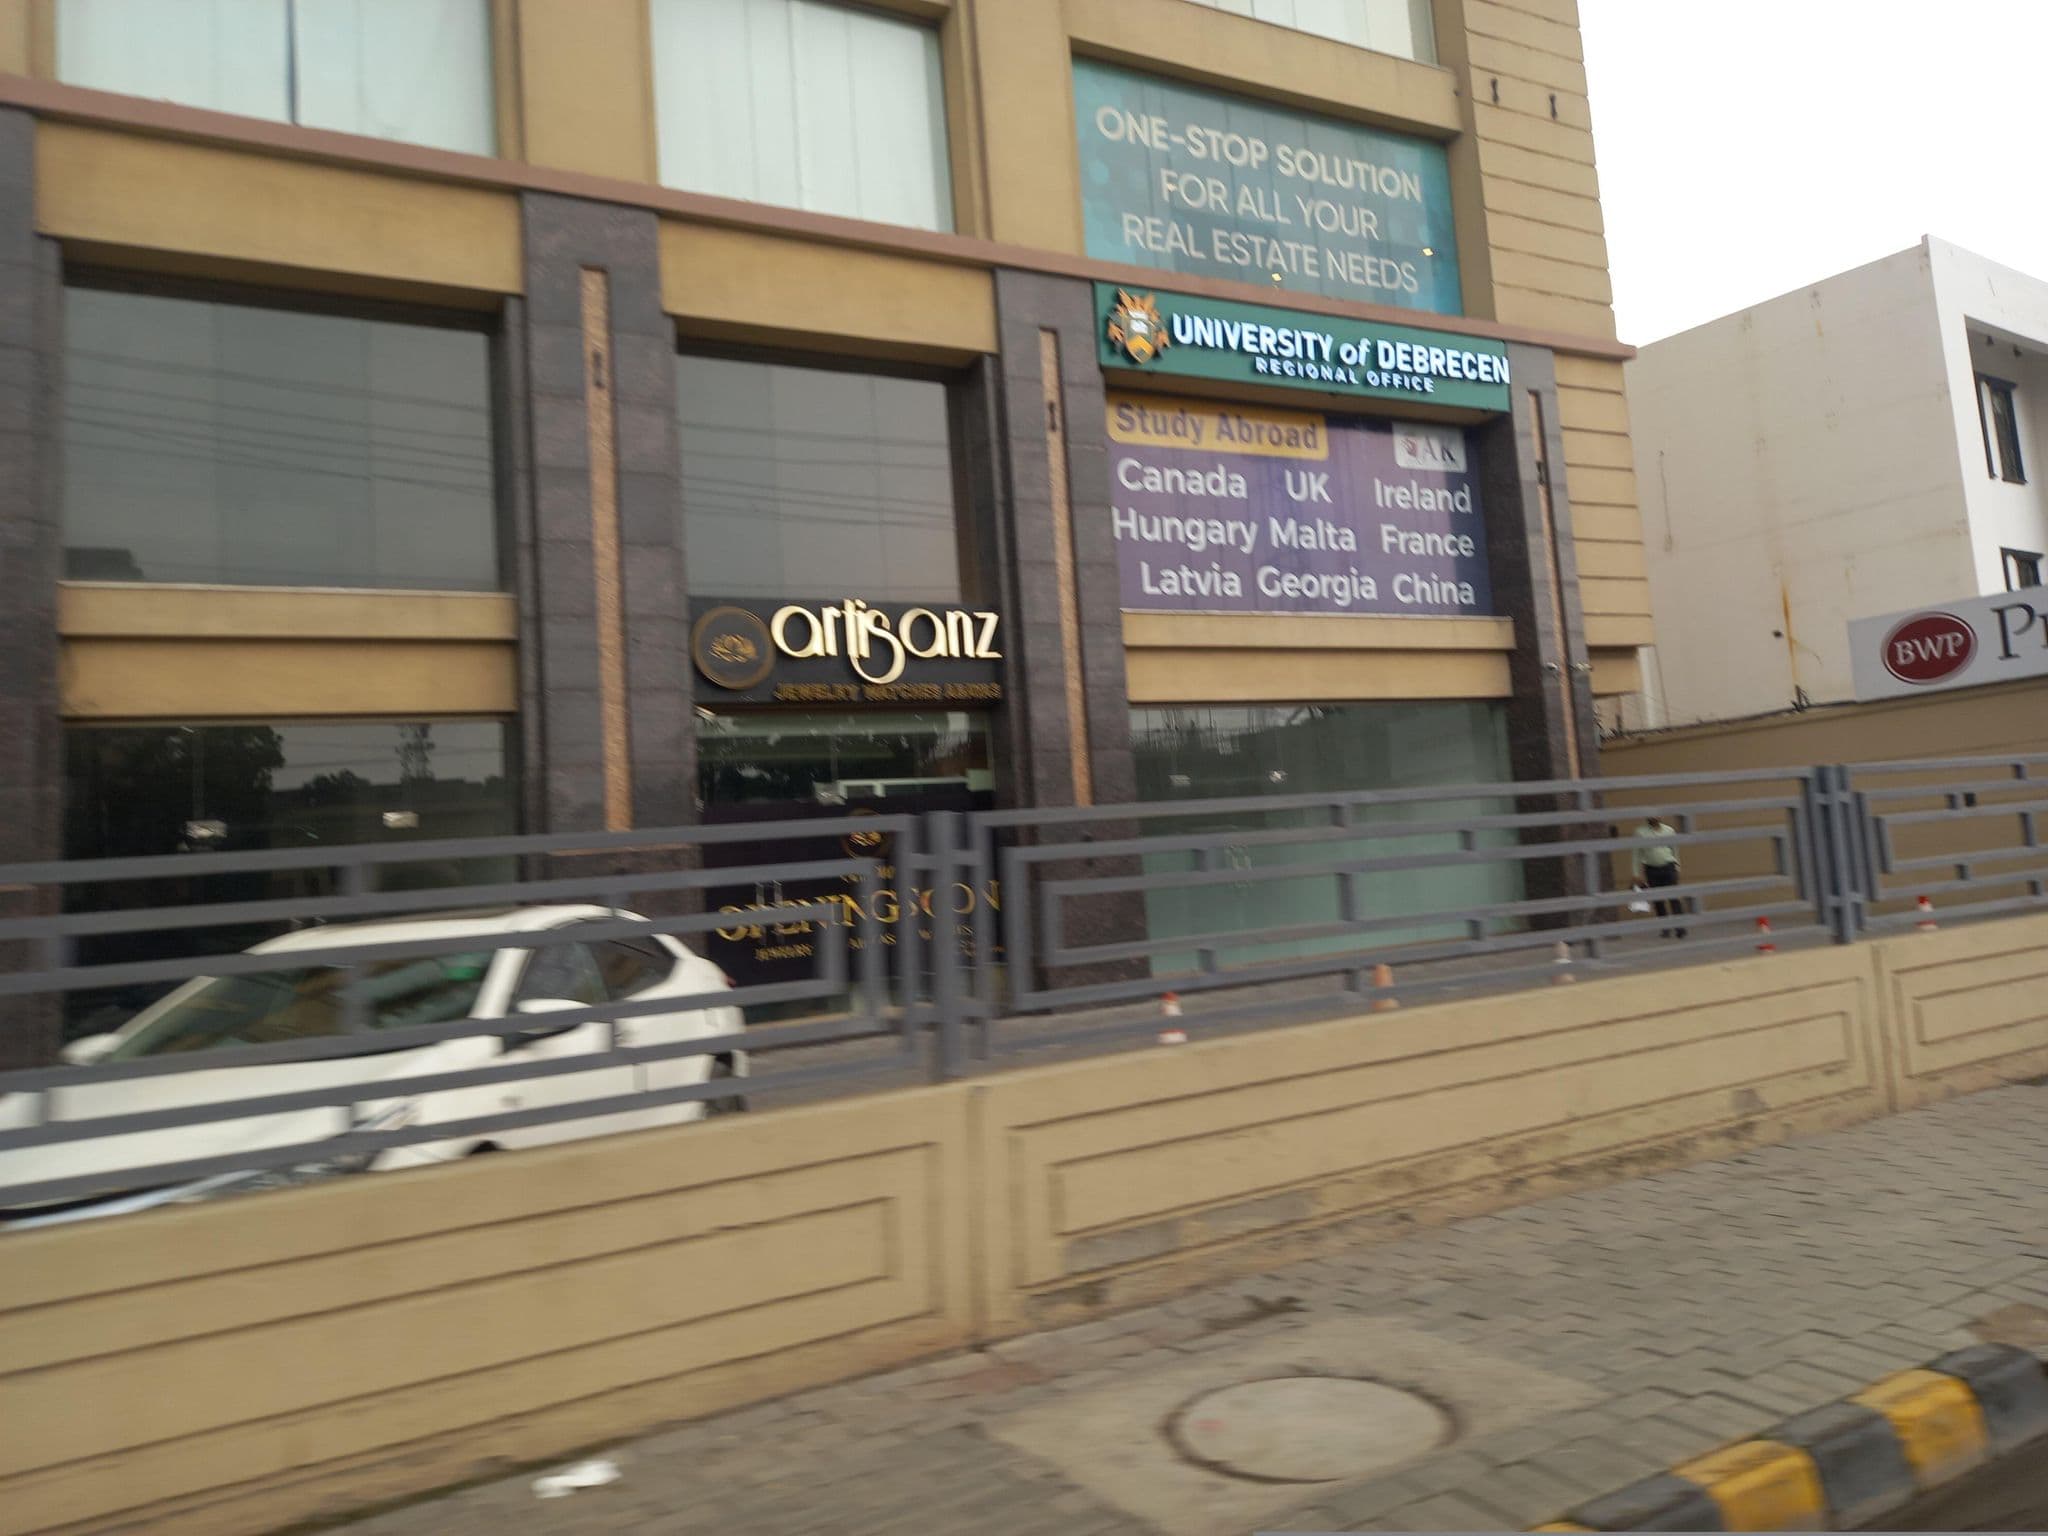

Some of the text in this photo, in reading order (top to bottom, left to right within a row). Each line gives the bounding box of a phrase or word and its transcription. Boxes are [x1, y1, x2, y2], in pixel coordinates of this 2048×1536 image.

[1095, 105, 1423, 204] ONE-STOP SOLUTION
[1160, 167, 1380, 241] FOR ALL YOUR
[1121, 212, 1421, 294] REAL ESTATE NEEDS
[1171, 312, 1512, 385] UNIVERSITY of DEBRECEN
[1255, 355, 1436, 394] REGIONAL OFFICE
[1115, 403, 1320, 450] Study Abroad
[1116, 456, 1474, 515] Canada UK Ireland
[1110, 505, 1475, 558] Hungary Malta France
[1140, 560, 1476, 608] Latvia Georgia China
[1894, 631, 1965, 666] BWP
